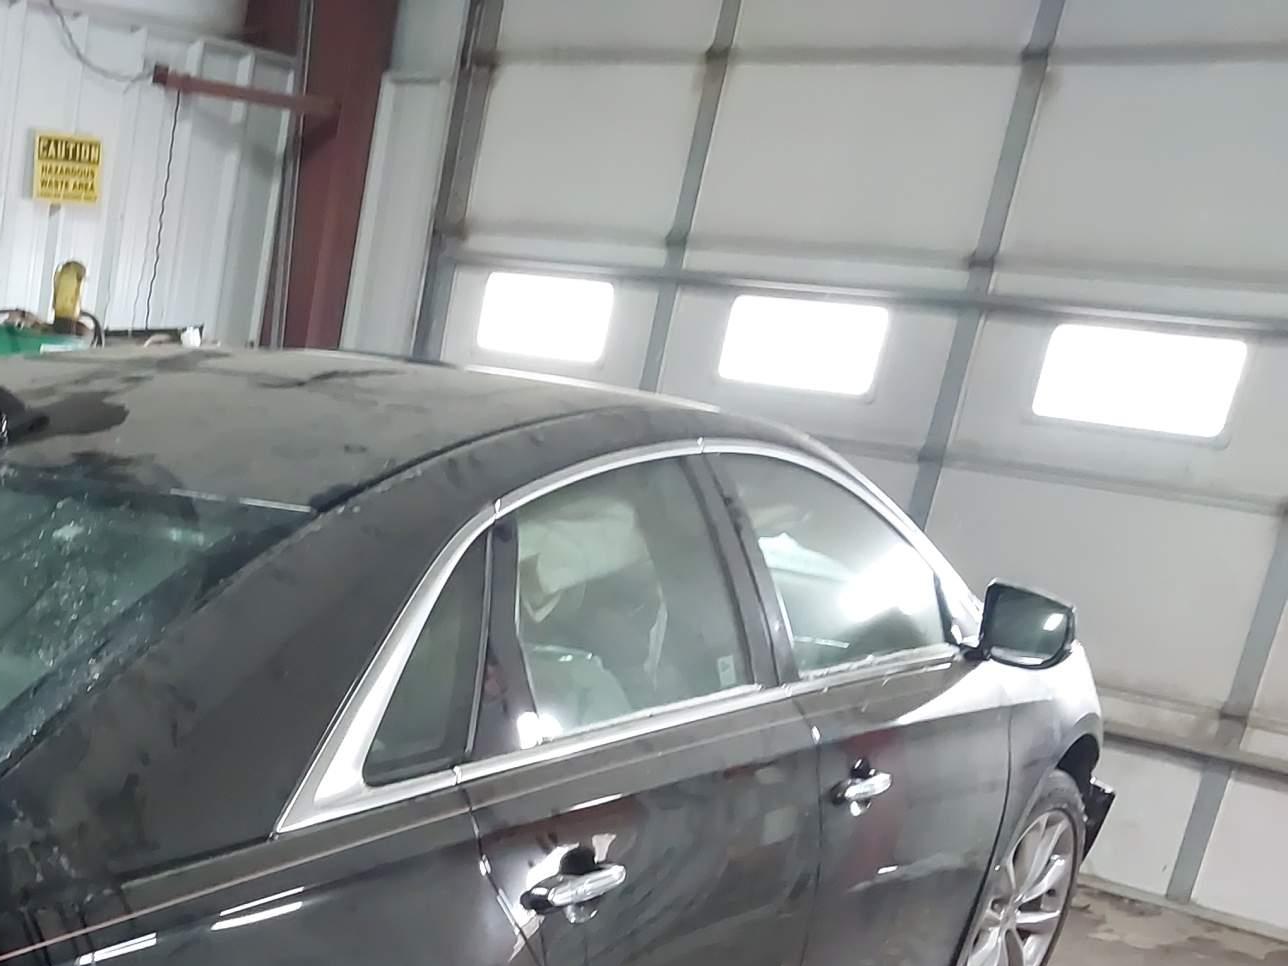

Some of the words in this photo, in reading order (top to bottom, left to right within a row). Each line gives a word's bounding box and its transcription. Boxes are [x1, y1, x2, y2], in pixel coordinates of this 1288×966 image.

[39, 138, 99, 163] CAUTION
[41, 164, 95, 179] HAZARDOUS
[40, 179, 69, 191] WASTE
[72, 180, 95, 192] AREA
